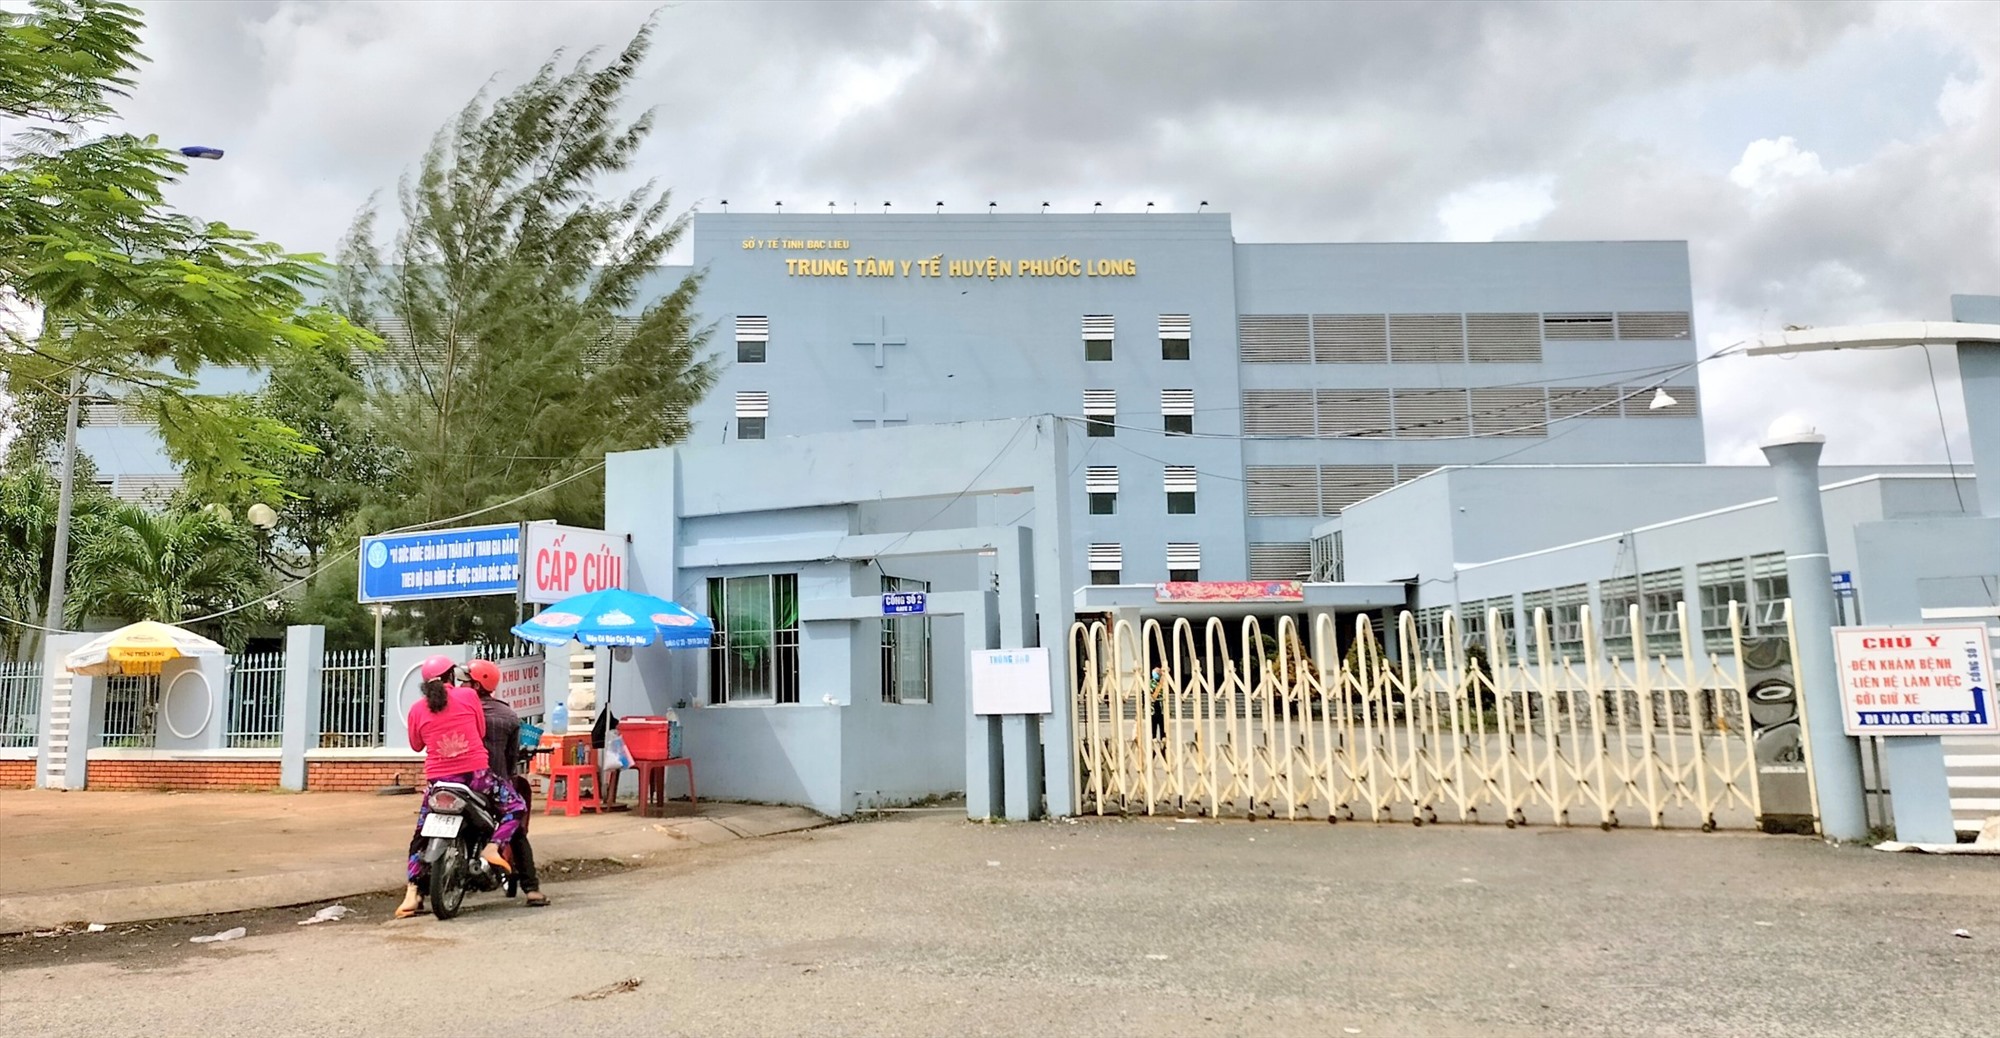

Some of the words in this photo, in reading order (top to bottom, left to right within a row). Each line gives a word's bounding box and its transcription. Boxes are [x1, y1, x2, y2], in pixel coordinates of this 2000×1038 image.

[758, 240, 764, 249] Y
[786, 258, 849, 277] TRUNG
[854, 256, 895, 278] TÂM
[900, 260, 912, 278] Y
[917, 253, 943, 278] TẾ
[949, 256, 1012, 281] HUYỆN
[1018, 254, 1082, 277] PHƯỚC
[1087, 259, 1136, 277] LONG
[536, 534, 578, 592] CẤP
[583, 544, 621, 593] CỨU
[886, 594, 906, 606] CỔNG
[906, 592, 916, 604] SỐ
[917, 594, 922, 604] 2
[1880, 658, 1916, 670] KHÁM
[1920, 657, 1952, 672] BỆNH
[502, 670, 520, 683] KHU
[522, 665, 539, 681] VỰC
[1884, 674, 1899, 690] HỆ
[1904, 675, 1930, 688] LÀM
[1934, 674, 1962, 690] VIỆC
[513, 698, 527, 709] MUA
[529, 694, 540, 706] BÁN
[1880, 692, 1899, 705] GIỮ
[1904, 693, 1920, 704] XE
[1881, 712, 1910, 724] VÀO
[1912, 710, 1949, 724] CỔNG
[1952, 711, 1970, 724] SỐ
[1974, 713, 1982, 724] 1
